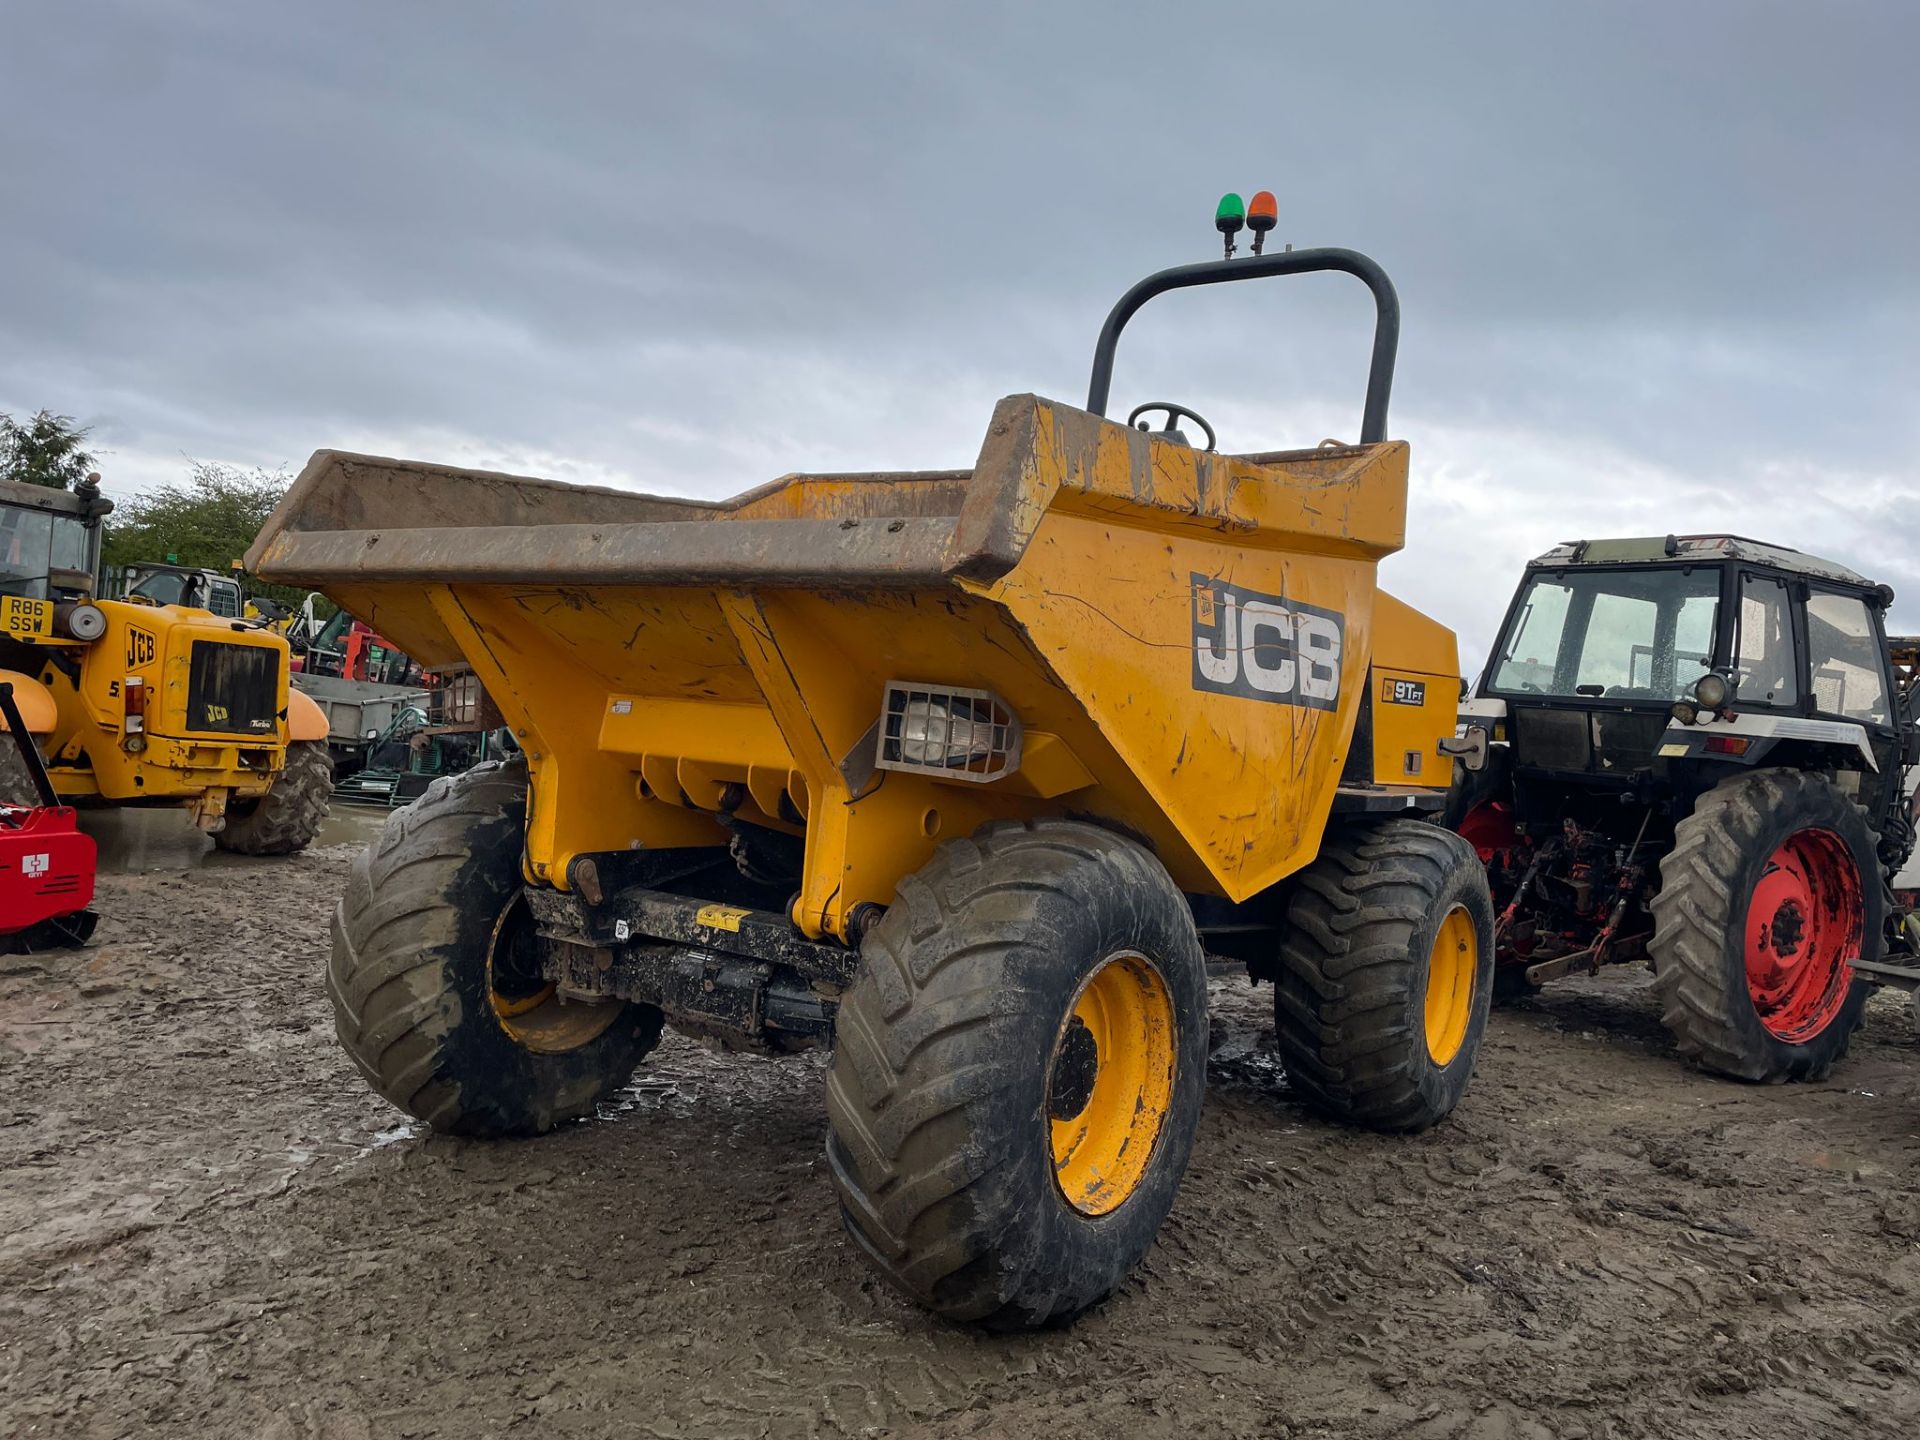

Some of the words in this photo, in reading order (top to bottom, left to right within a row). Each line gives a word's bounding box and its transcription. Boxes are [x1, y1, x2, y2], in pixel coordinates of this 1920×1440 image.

[11, 599, 43, 616] R86
[10, 616, 43, 633] SSW
[127, 628, 155, 668] JCB
[1197, 592, 1342, 702] JCB
